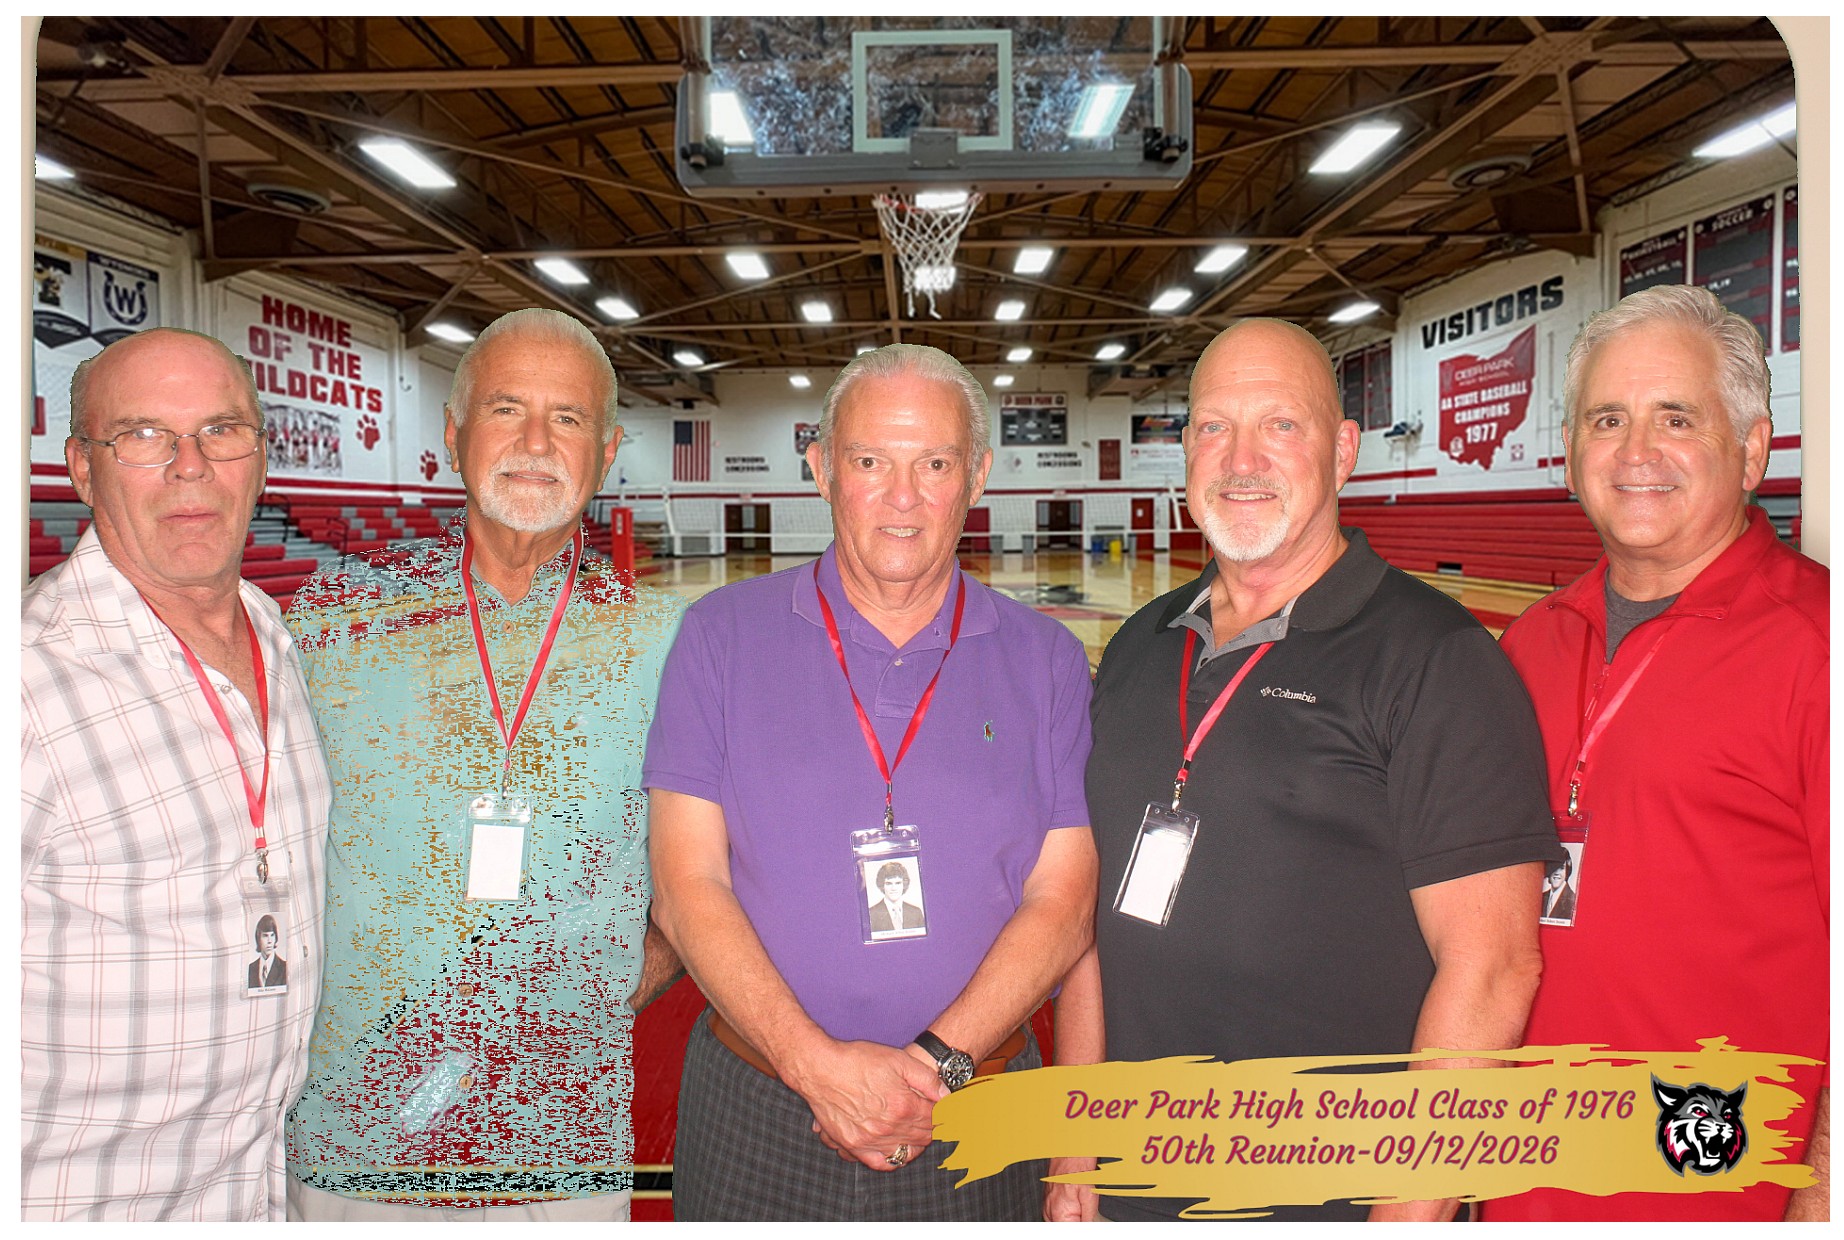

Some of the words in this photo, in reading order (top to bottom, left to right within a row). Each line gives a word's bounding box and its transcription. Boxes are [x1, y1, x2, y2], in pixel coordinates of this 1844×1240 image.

[1711, 208, 1754, 232] SOCCER
[262, 294, 351, 349] HOME
[1421, 275, 1564, 349] VISITORS
[249, 325, 292, 362] OF
[307, 341, 361, 381] THE
[1455, 365, 1482, 380] DEER
[1483, 356, 1515, 373] PARK
[246, 358, 383, 413] ILDCATS
[1441, 397, 1452, 411] AA
[1454, 391, 1479, 408] STATE
[1481, 380, 1528, 402] BASEBALL
[1454, 402, 1510, 425] CHAMPIONS
[1465, 422, 1498, 444] 1977
[1271, 687, 1317, 704] Columbia
